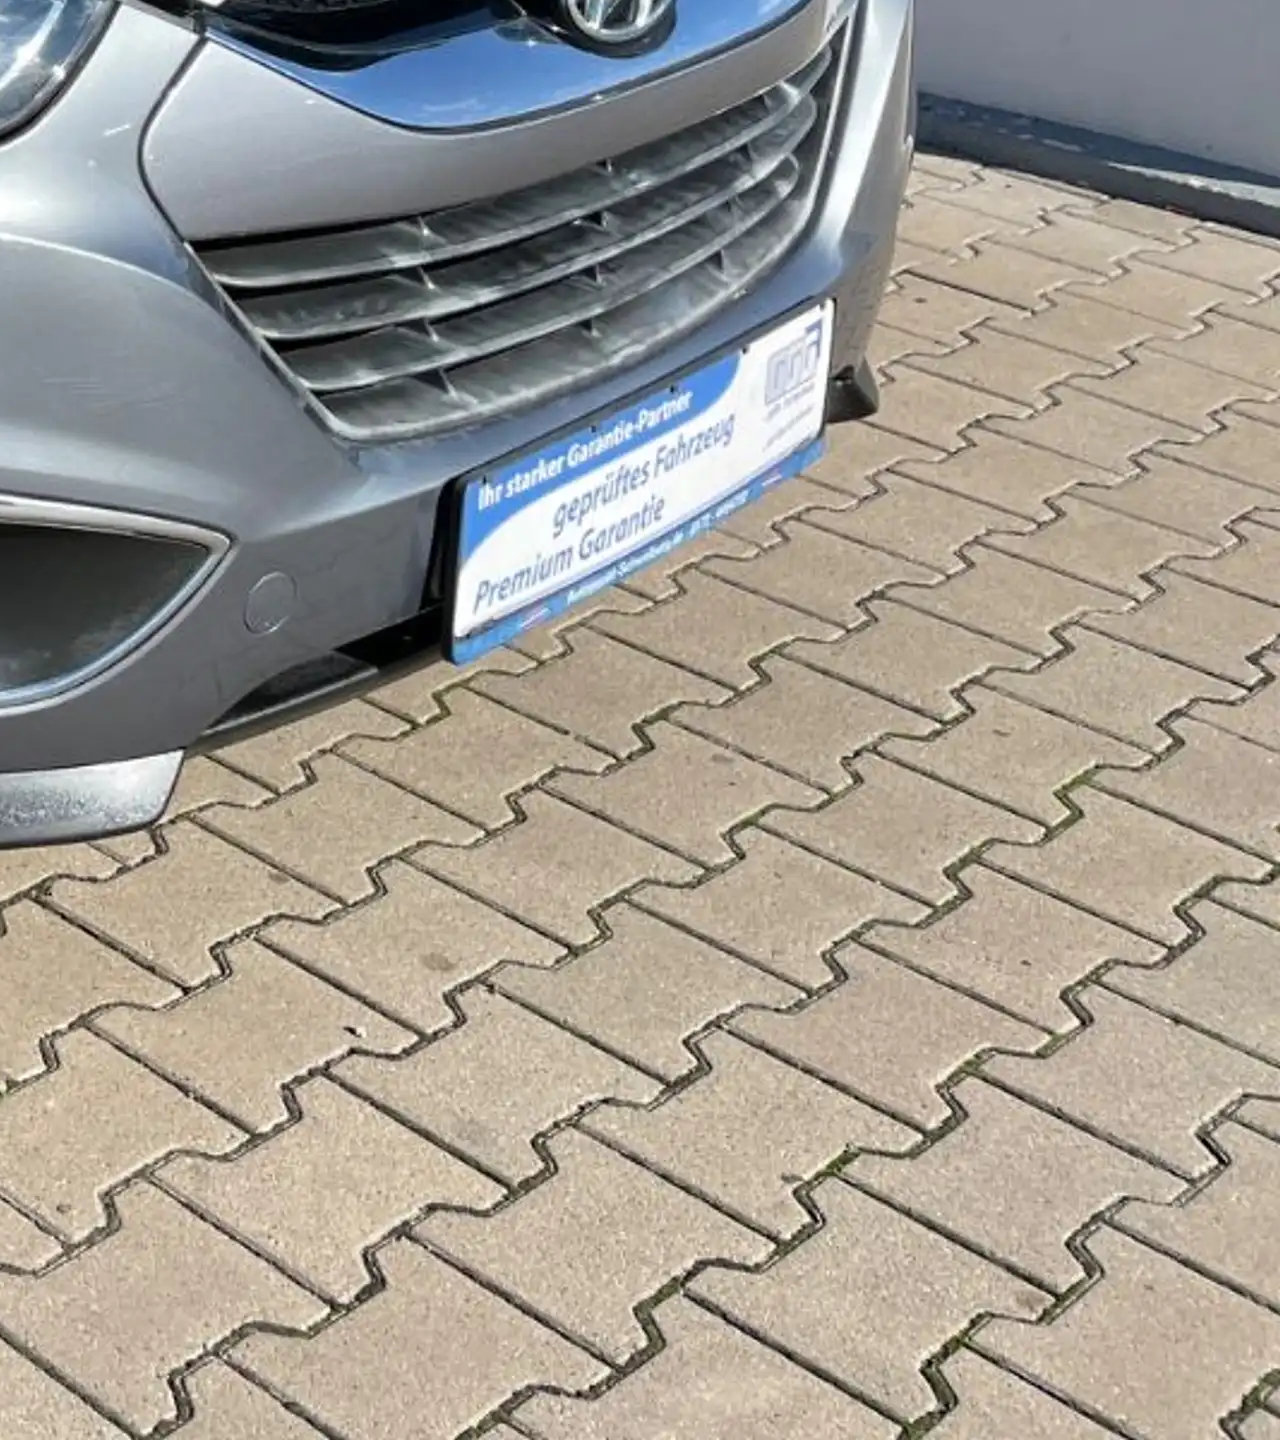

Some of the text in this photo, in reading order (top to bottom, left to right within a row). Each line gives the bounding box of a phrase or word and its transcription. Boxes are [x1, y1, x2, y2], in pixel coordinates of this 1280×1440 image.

[478, 390, 694, 511] Ihr starker Garantie-Partner
[552, 412, 737, 540] geprüftes Fahrzeug
[472, 544, 574, 614] Premium
[578, 493, 665, 562] Garantie
